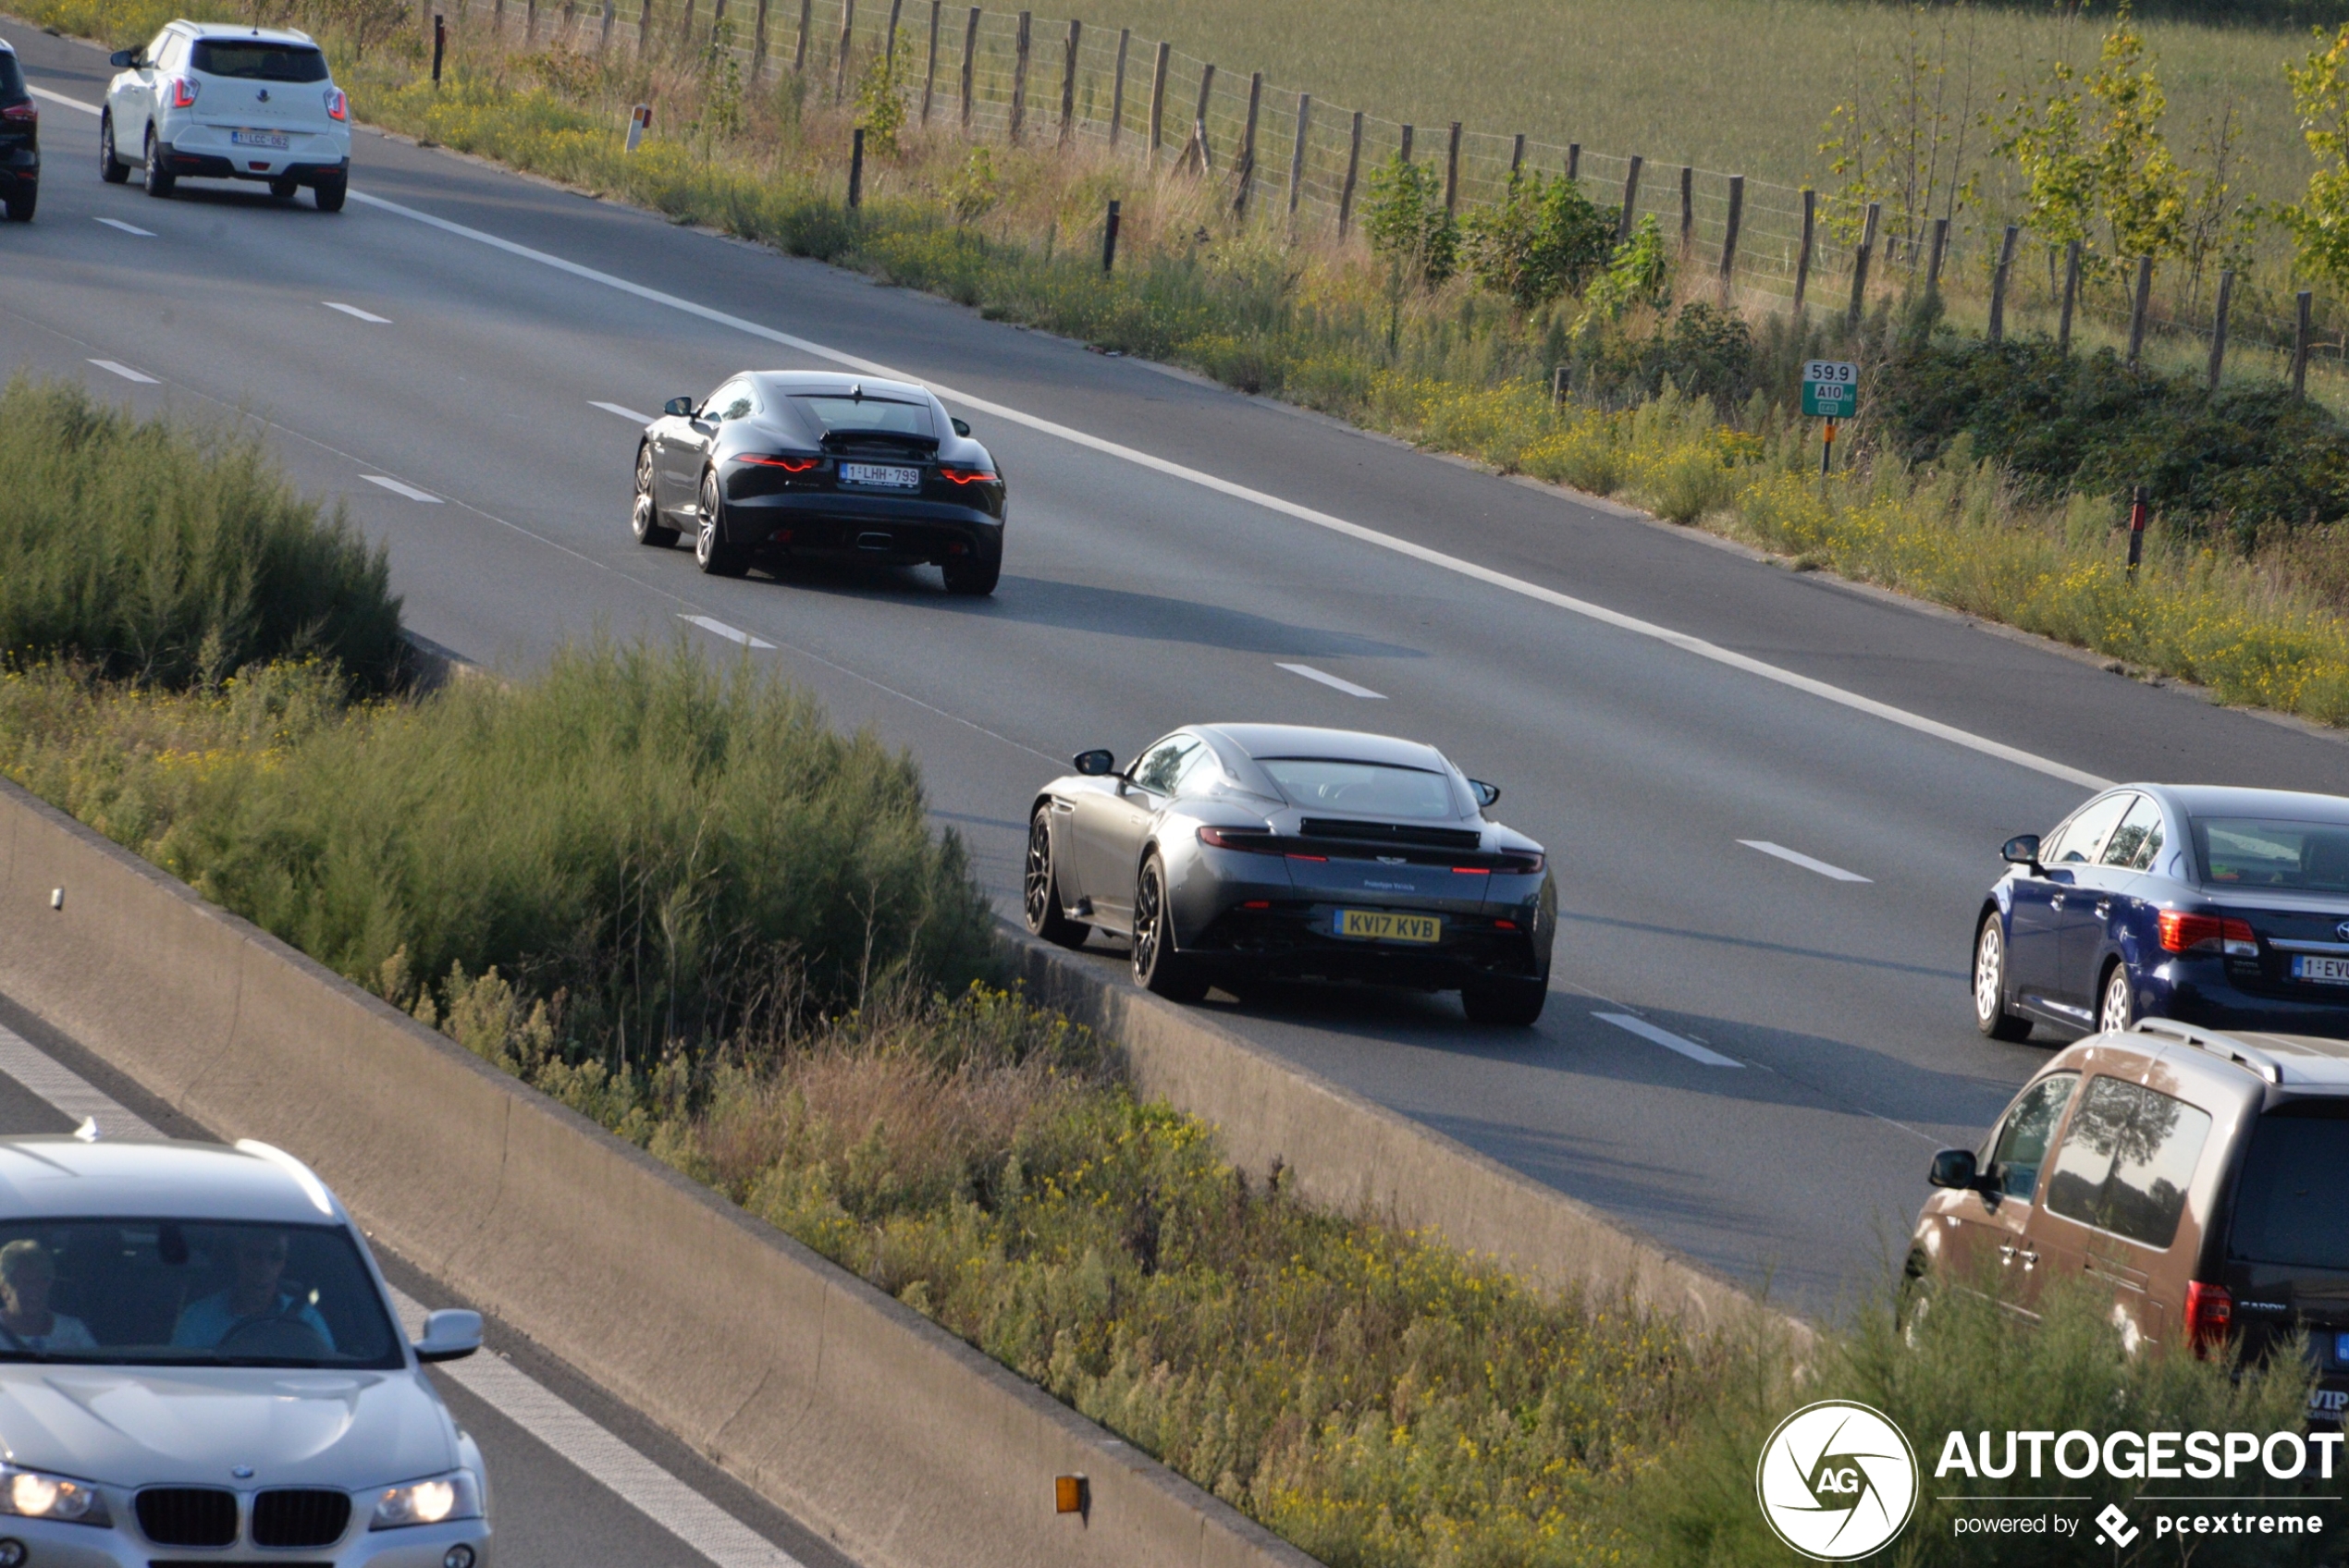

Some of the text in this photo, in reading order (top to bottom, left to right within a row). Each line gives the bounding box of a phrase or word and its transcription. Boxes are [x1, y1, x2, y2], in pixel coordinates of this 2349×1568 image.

[1813, 364, 1850, 381] 59.9
[1817, 386, 1842, 398] A10
[1350, 914, 1433, 937] KV17 KVB
[2307, 1390, 2349, 1410] VIP
